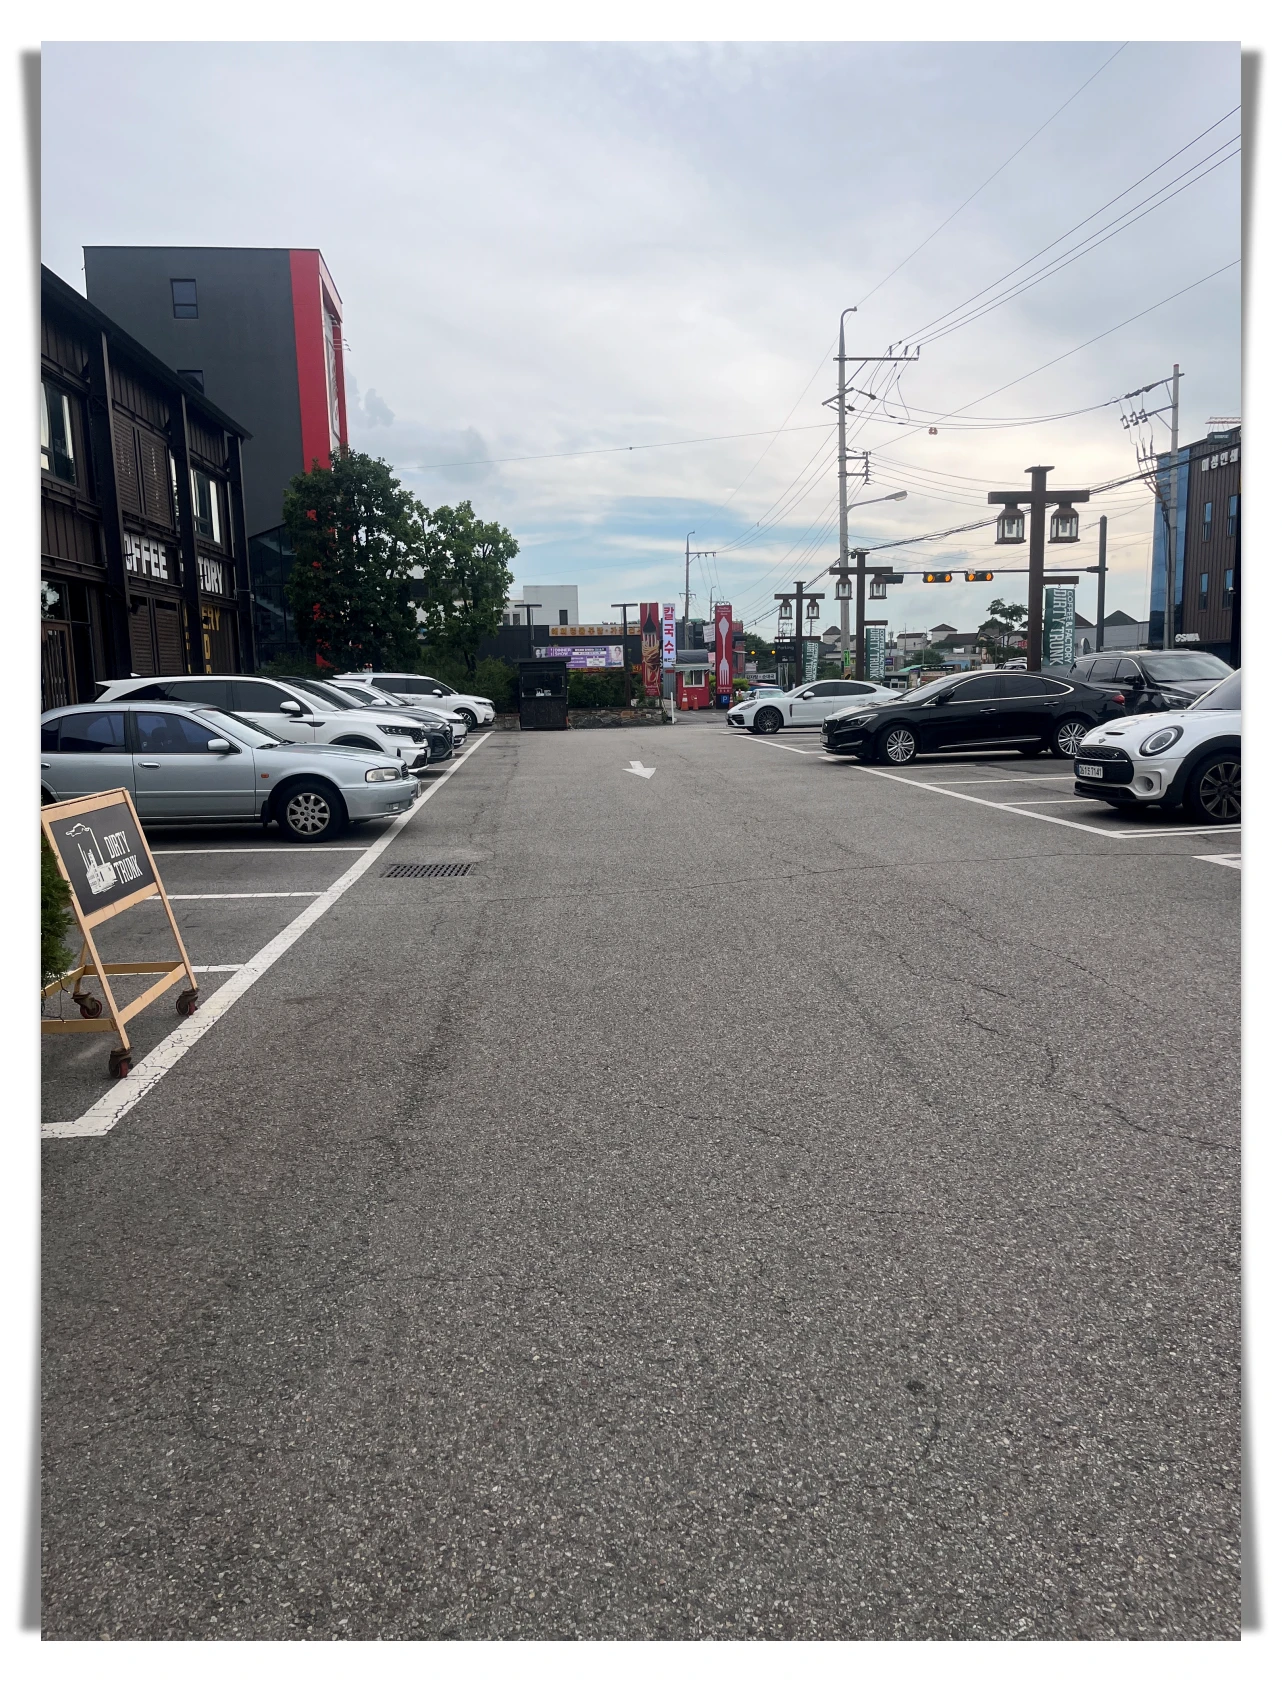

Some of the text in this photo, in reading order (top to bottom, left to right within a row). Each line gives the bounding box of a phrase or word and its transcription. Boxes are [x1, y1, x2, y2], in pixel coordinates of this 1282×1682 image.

[1066, 590, 1074, 621] COFFEE
[664, 606, 675, 655] 칼국수
[1049, 588, 1067, 666] DIRTY TRUNK
[869, 629, 880, 679] DIRTY TRUNK
[1064, 628, 1073, 664] FACTORY
[722, 695, 728, 703] P
[103, 830, 131, 859] DIRTY
[113, 854, 144, 885] TRUNK
